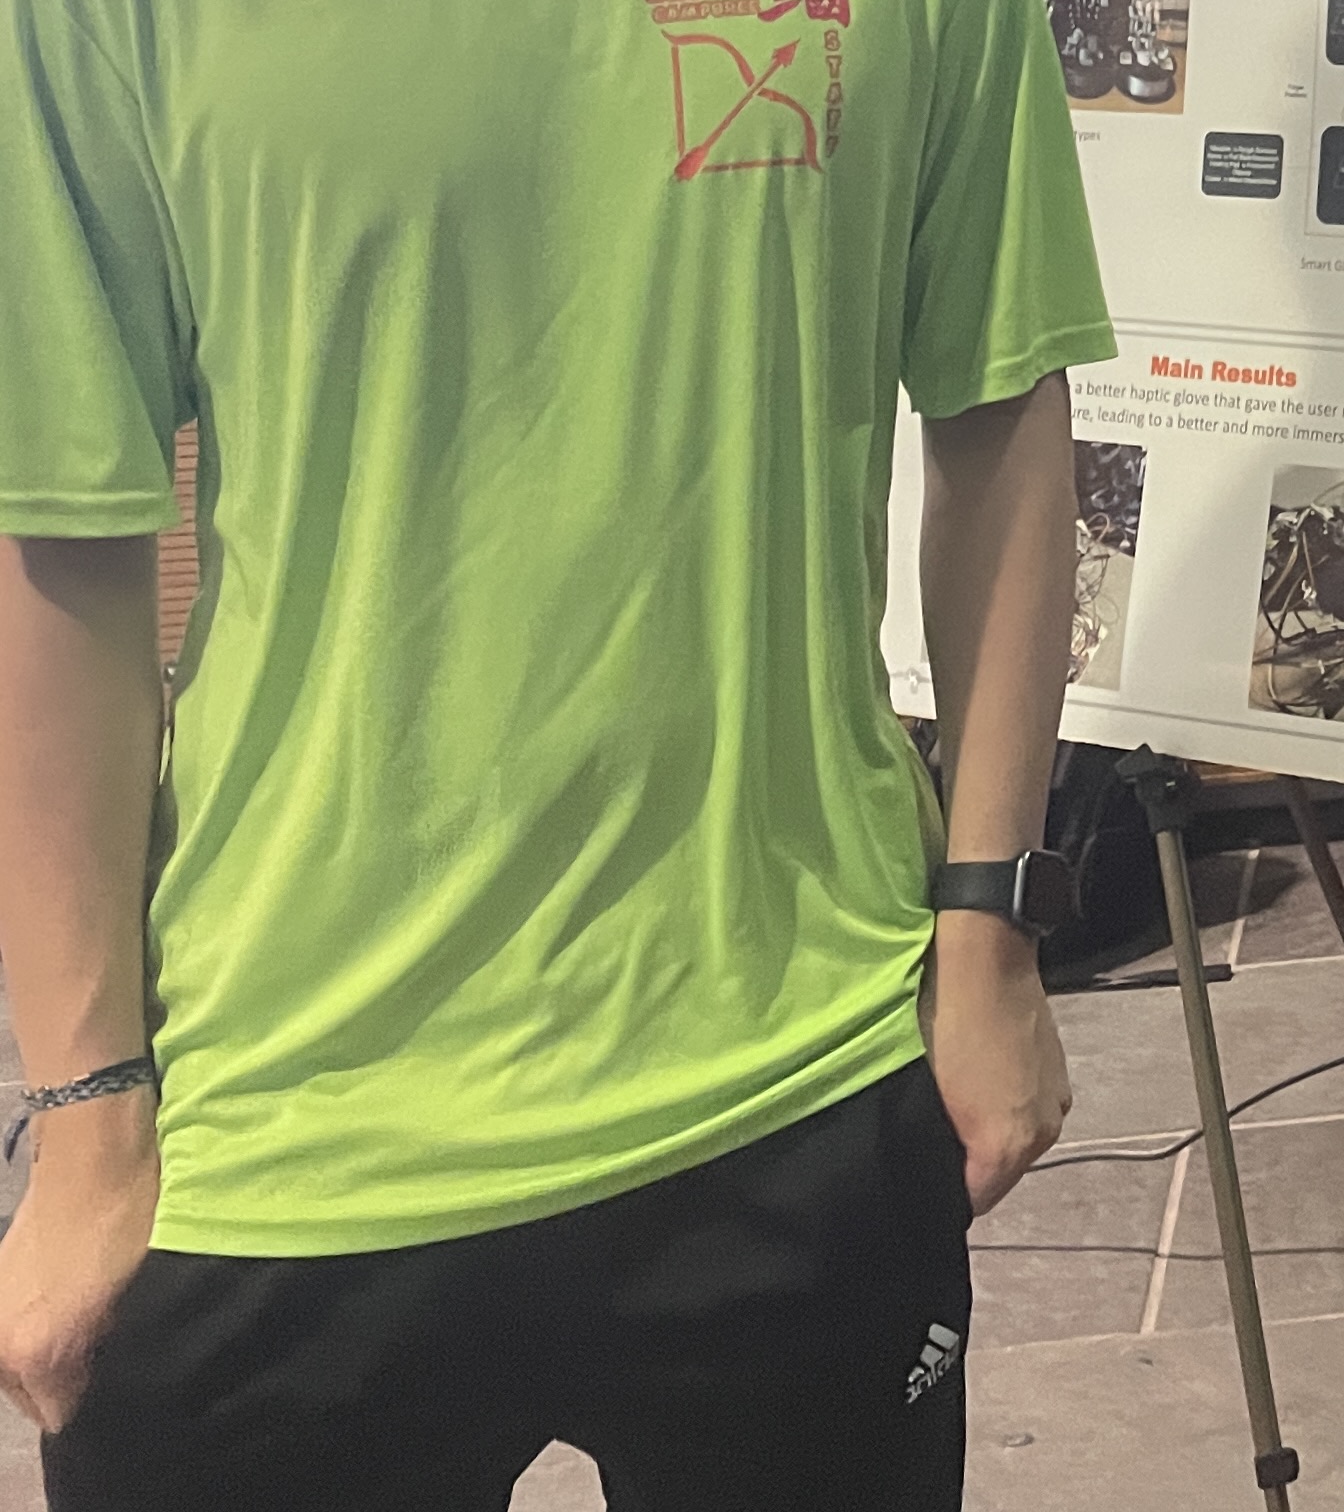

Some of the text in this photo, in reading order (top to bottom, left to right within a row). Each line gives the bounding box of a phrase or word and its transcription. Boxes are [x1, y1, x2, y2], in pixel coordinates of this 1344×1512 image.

[1150, 356, 1298, 388] Main Results
[1075, 382, 1083, 395] a
[1086, 380, 1127, 398] better
[1130, 383, 1170, 405] haptic
[1173, 389, 1210, 407] glove
[1213, 394, 1241, 410] that
[1244, 398, 1277, 413] gave
[1281, 398, 1304, 415] the
[1308, 402, 1338, 418] user
[1097, 406, 1145, 429] leading
[1148, 414, 1163, 428] to
[1166, 417, 1174, 428] a
[1177, 414, 1218, 433] better
[1222, 420, 1249, 435] and
[1252, 424, 1290, 439] more
